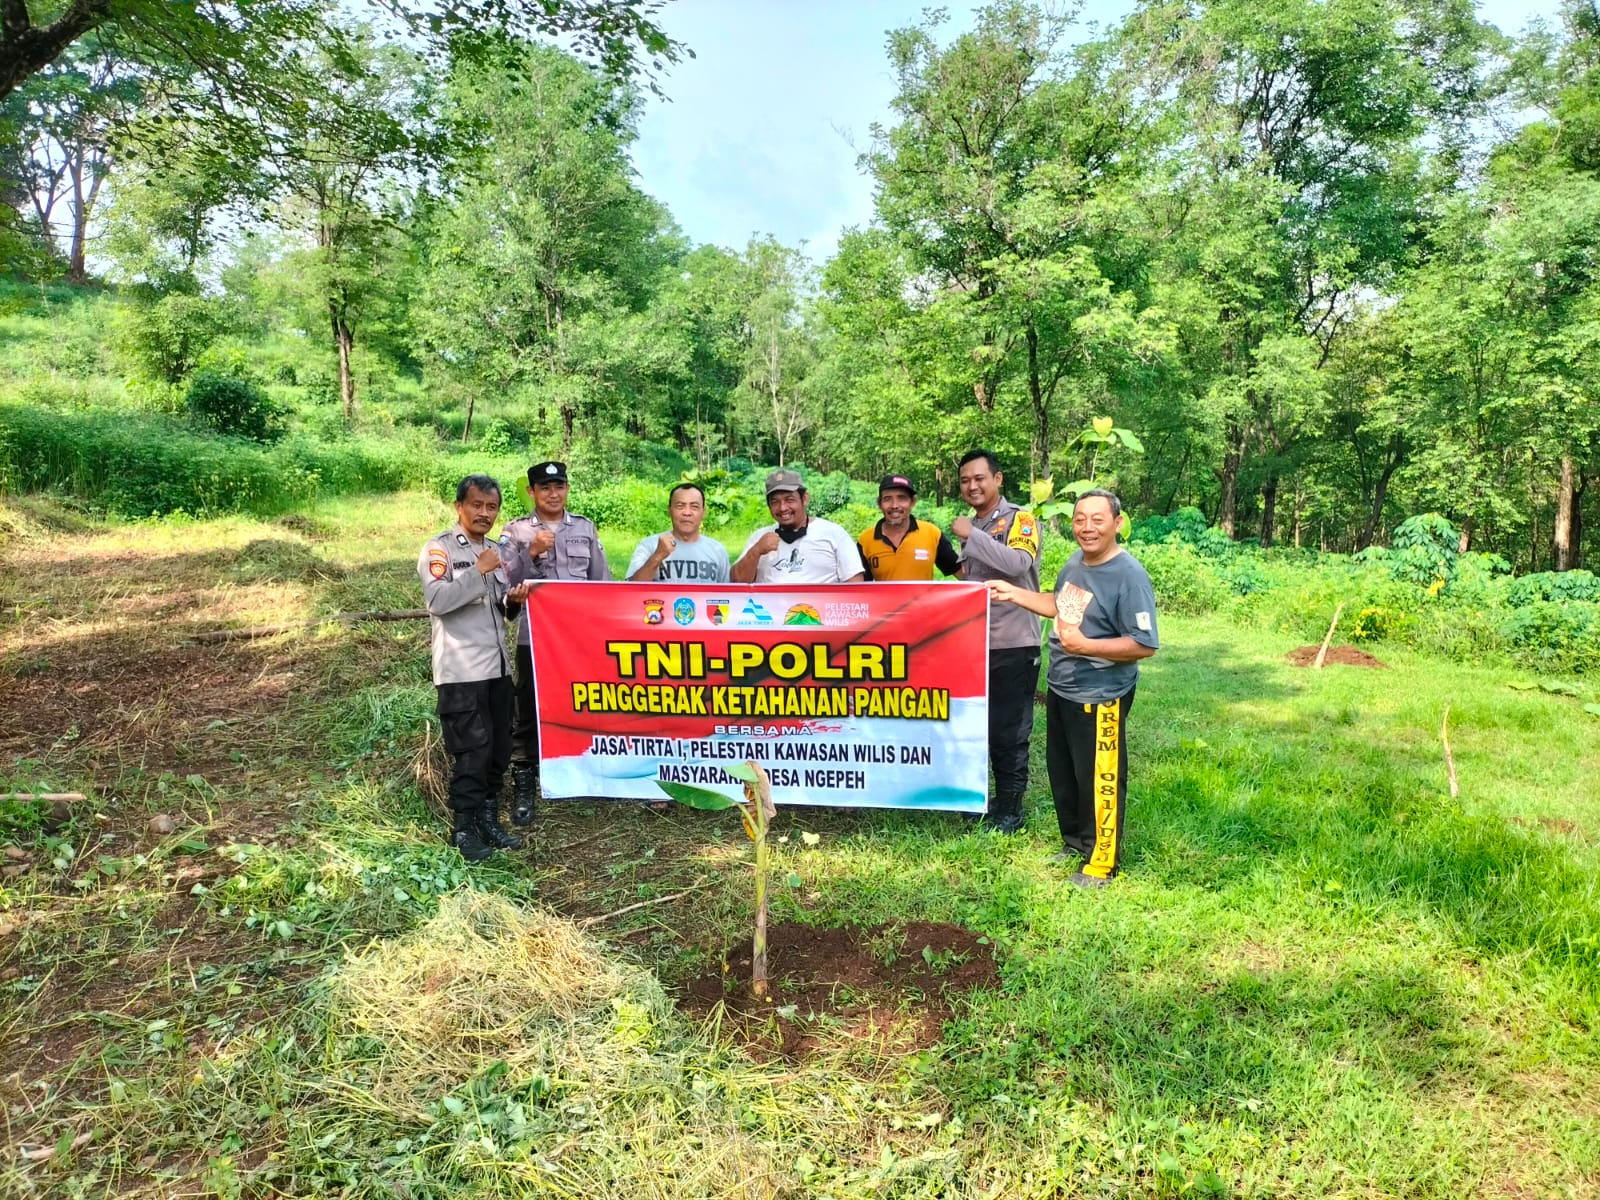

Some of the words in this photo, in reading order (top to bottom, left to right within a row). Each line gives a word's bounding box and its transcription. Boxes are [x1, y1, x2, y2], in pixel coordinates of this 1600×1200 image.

[659, 560, 717, 580] NVD96
[825, 603, 869, 611] PELESTARI
[825, 610, 869, 618] KAWASAN
[825, 618, 849, 627] WILIS
[607, 641, 906, 681] TNI-POLRI
[572, 682, 707, 715] PENGGERAK
[712, 685, 849, 717] KETAHANAN
[854, 687, 949, 721] PANGAN
[714, 725, 813, 736] BERSAMA
[591, 737, 628, 756] JASA
[632, 739, 674, 757] TIRTA
[678, 740, 688, 761] I,
[691, 741, 770, 760] PELESTARI
[775, 743, 849, 762] KAWASAN
[854, 744, 896, 763] WILIS
[901, 746, 932, 765] DAN
[805, 769, 865, 789] NGEPEH
